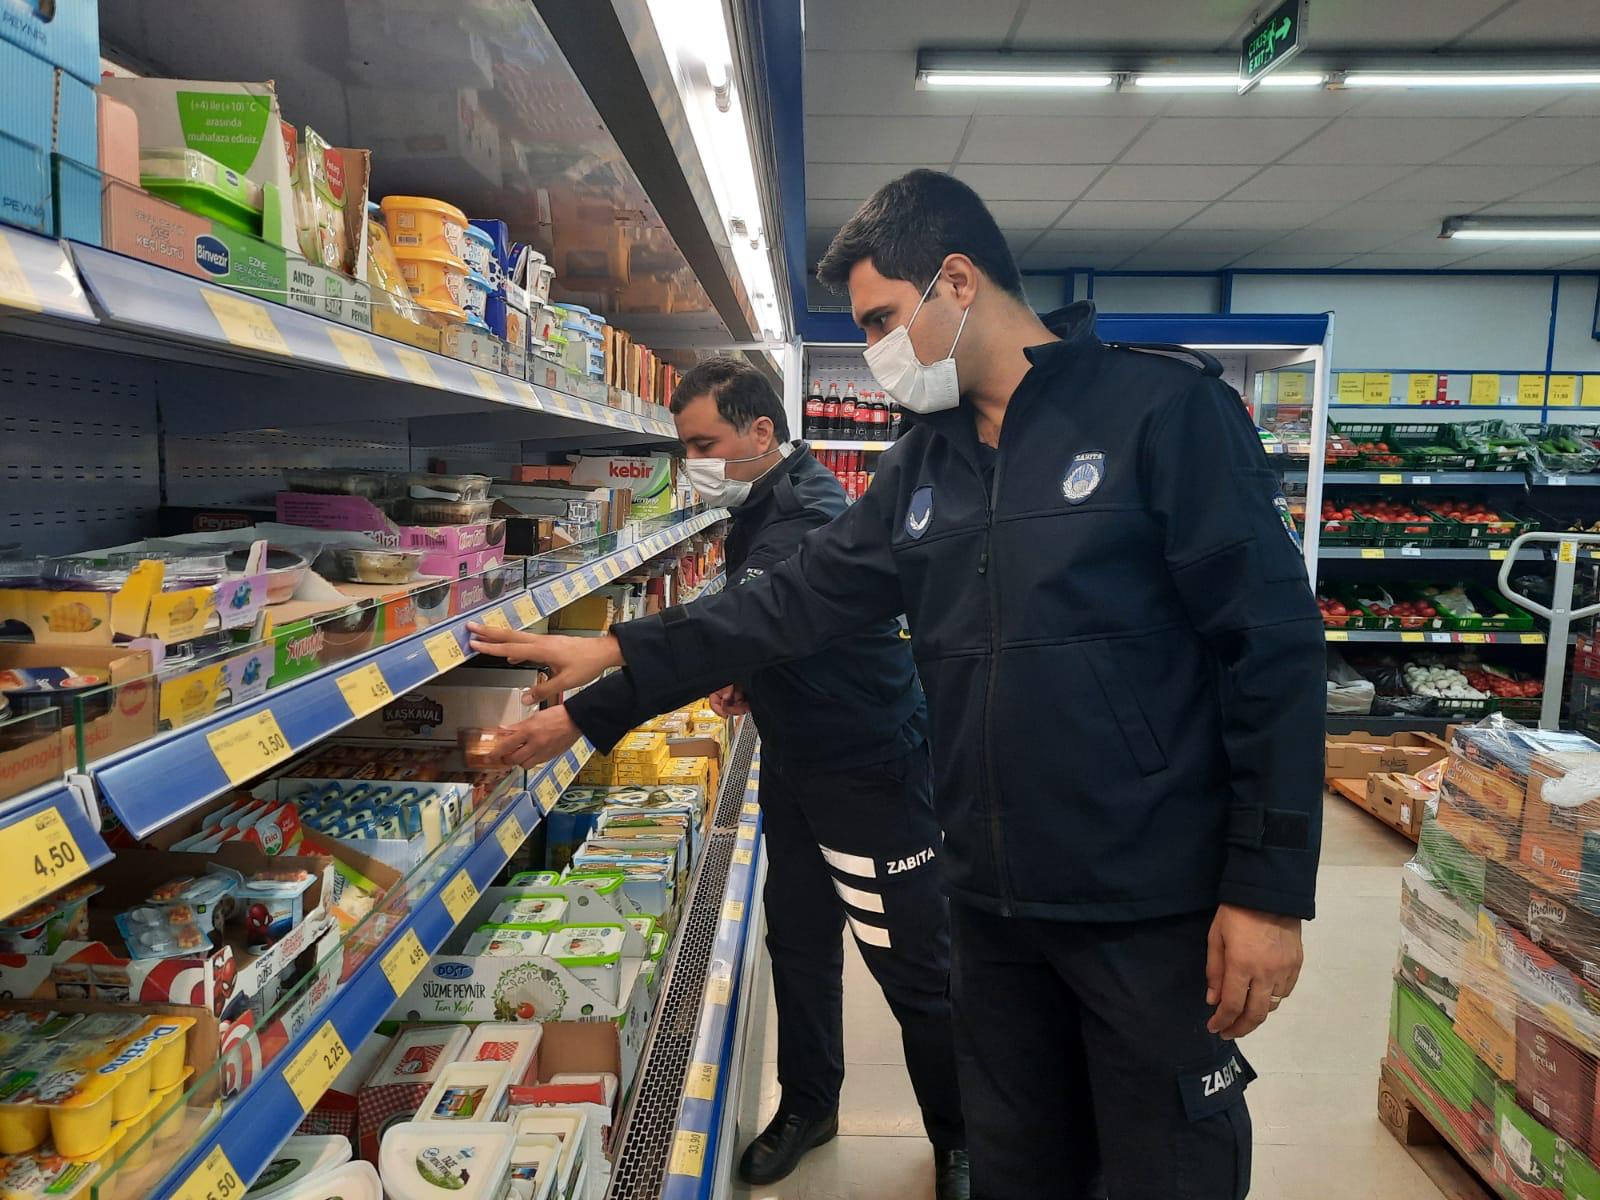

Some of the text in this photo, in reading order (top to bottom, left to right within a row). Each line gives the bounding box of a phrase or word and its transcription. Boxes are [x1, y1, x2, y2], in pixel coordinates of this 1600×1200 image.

[187, 132, 230, 143] muhafaza
[197, 243, 229, 269] Binvezir
[292, 270, 315, 288] ANTEP
[609, 461, 655, 478] kebir
[258, 733, 286, 757] 3,50
[34, 840, 76, 877] 4,50
[886, 846, 936, 875] ZABITA
[409, 944, 425, 966] 4,95
[438, 963, 470, 977] DOST
[423, 980, 486, 999] SÜZME PEYNİR
[323, 1041, 345, 1071] 2,25
